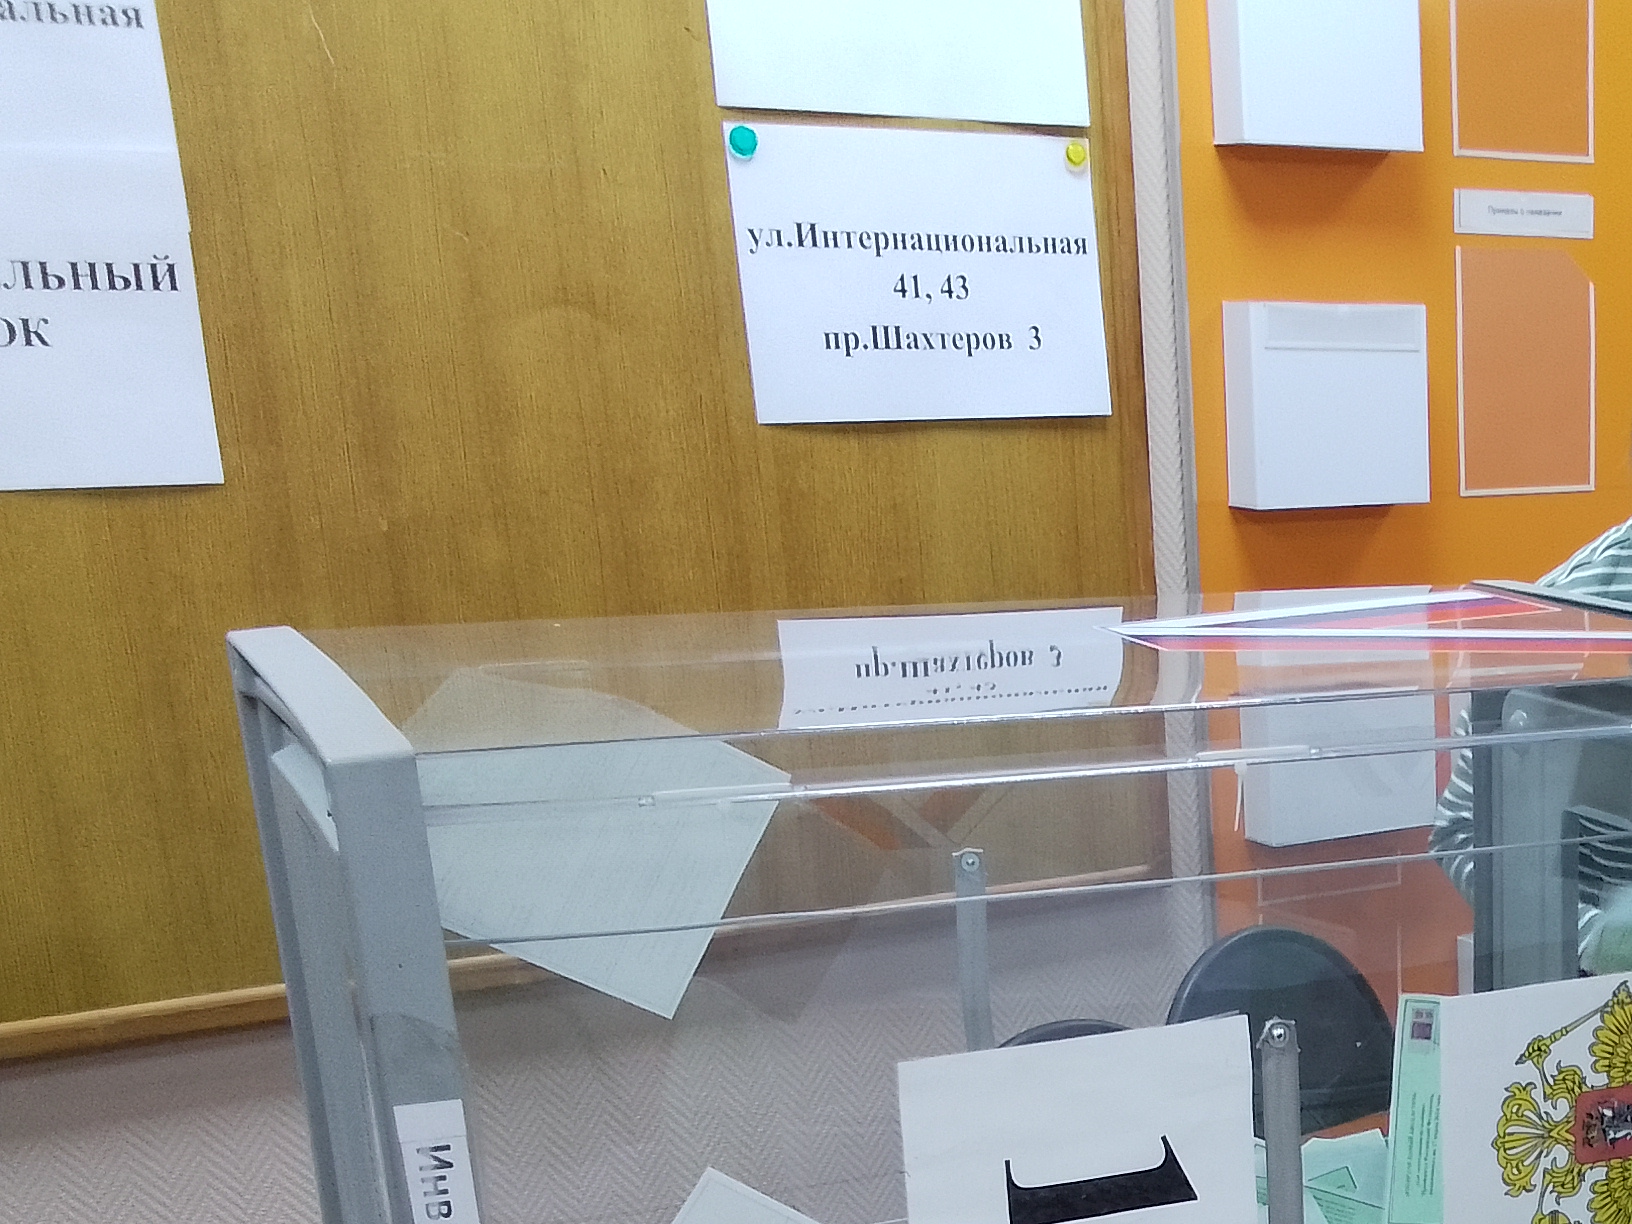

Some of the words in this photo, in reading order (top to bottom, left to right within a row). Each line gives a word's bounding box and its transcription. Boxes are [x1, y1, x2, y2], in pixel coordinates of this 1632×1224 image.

[747, 221, 1088, 258] ул.Интернациональная
[893, 273, 933, 304] 41,
[940, 274, 970, 301] 43
[823, 325, 1013, 357] пр.Шахтеров
[1028, 326, 1042, 351] 3
